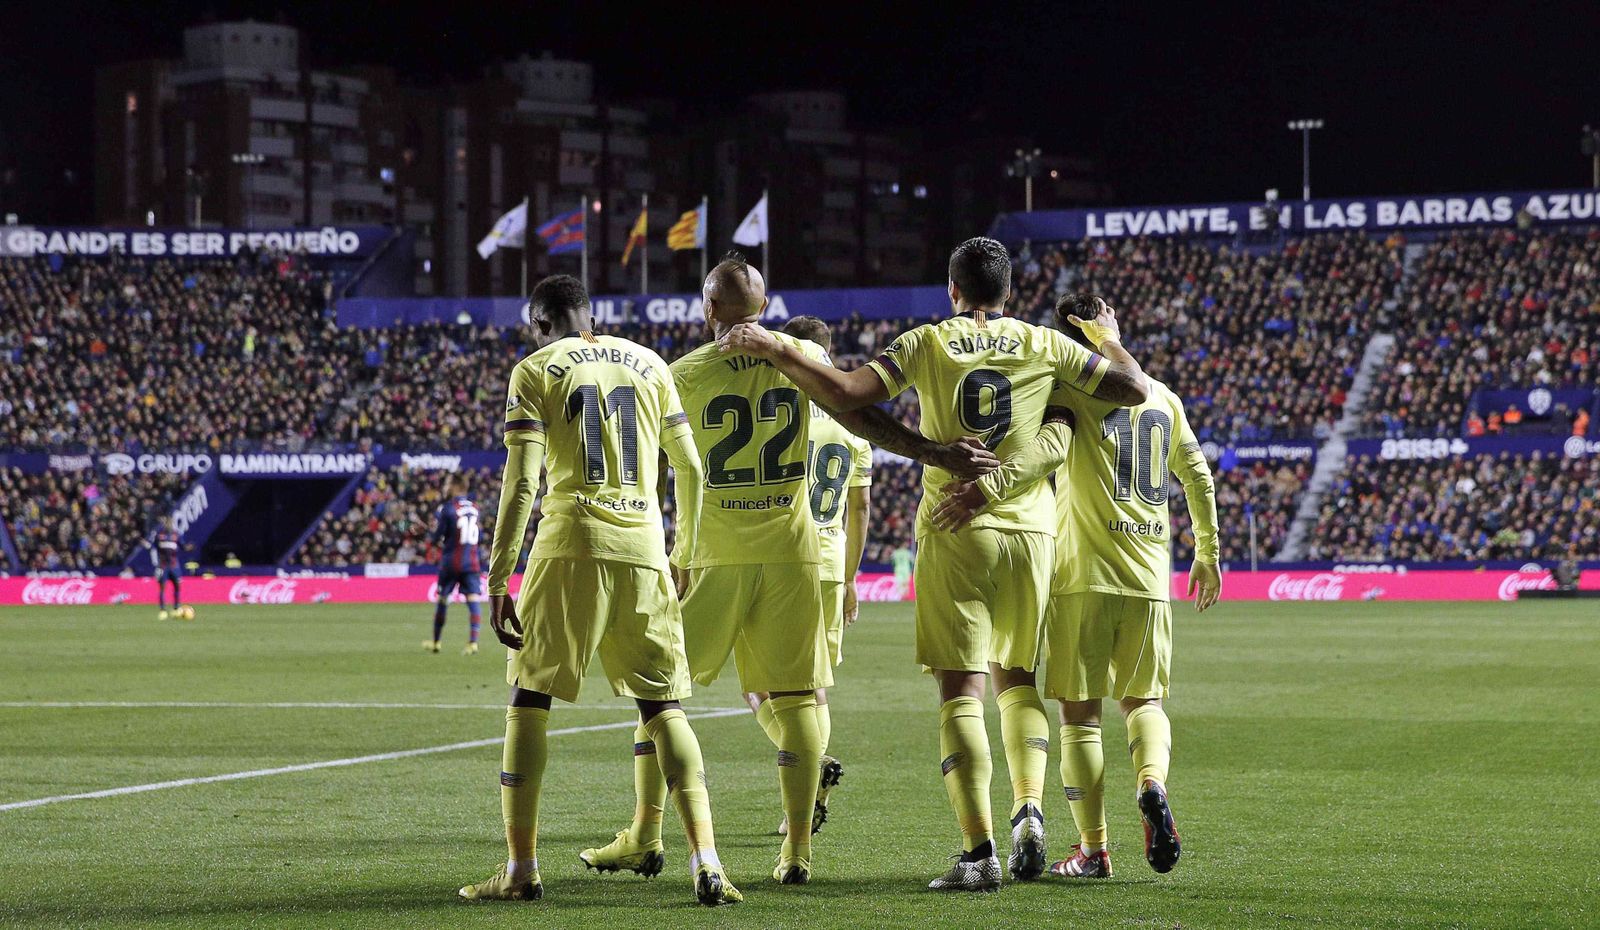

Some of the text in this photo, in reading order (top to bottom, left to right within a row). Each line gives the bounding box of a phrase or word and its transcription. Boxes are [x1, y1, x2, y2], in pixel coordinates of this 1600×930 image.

[1086, 208, 1237, 236] LEVANTE,
[1304, 203, 1367, 228] LAS
[1376, 197, 1513, 226] BARRAS
[1525, 193, 1600, 220] AZU
[7, 231, 126, 254] GRANDE
[131, 232, 167, 255] ES
[171, 232, 225, 255] SER
[948, 333, 1020, 355] SUÁREZ
[957, 369, 1012, 449] 9
[566, 384, 638, 486] 11
[702, 387, 806, 489] 22
[137, 454, 212, 474] GRUPO
[219, 454, 366, 473] RAMINATRANS
[1102, 405, 1172, 505] 10
[721, 495, 772, 510] unicef
[1108, 519, 1151, 535] unicef
